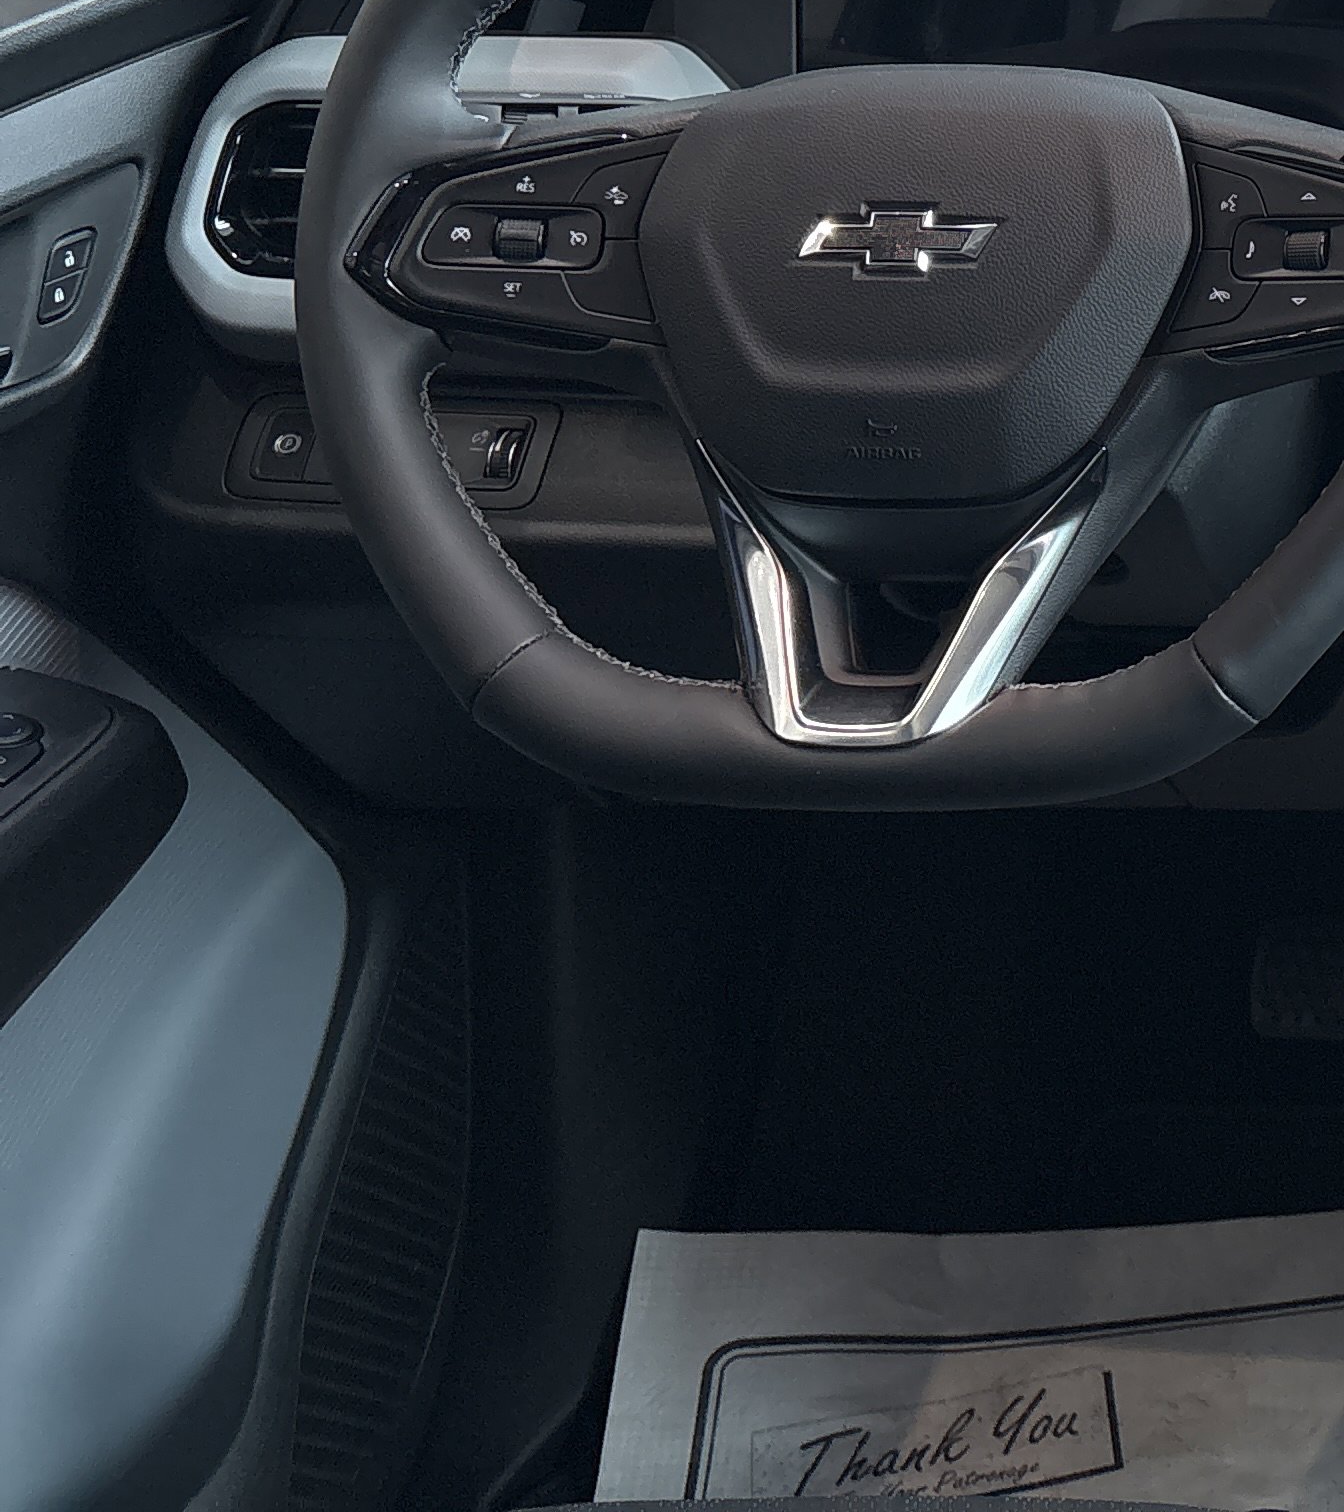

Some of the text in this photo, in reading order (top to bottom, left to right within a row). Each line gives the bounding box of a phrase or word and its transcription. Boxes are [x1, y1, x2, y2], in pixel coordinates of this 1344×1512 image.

[516, 182, 535, 192] RES
[503, 282, 523, 293] SET
[795, 1388, 1078, 1498] Thank You
